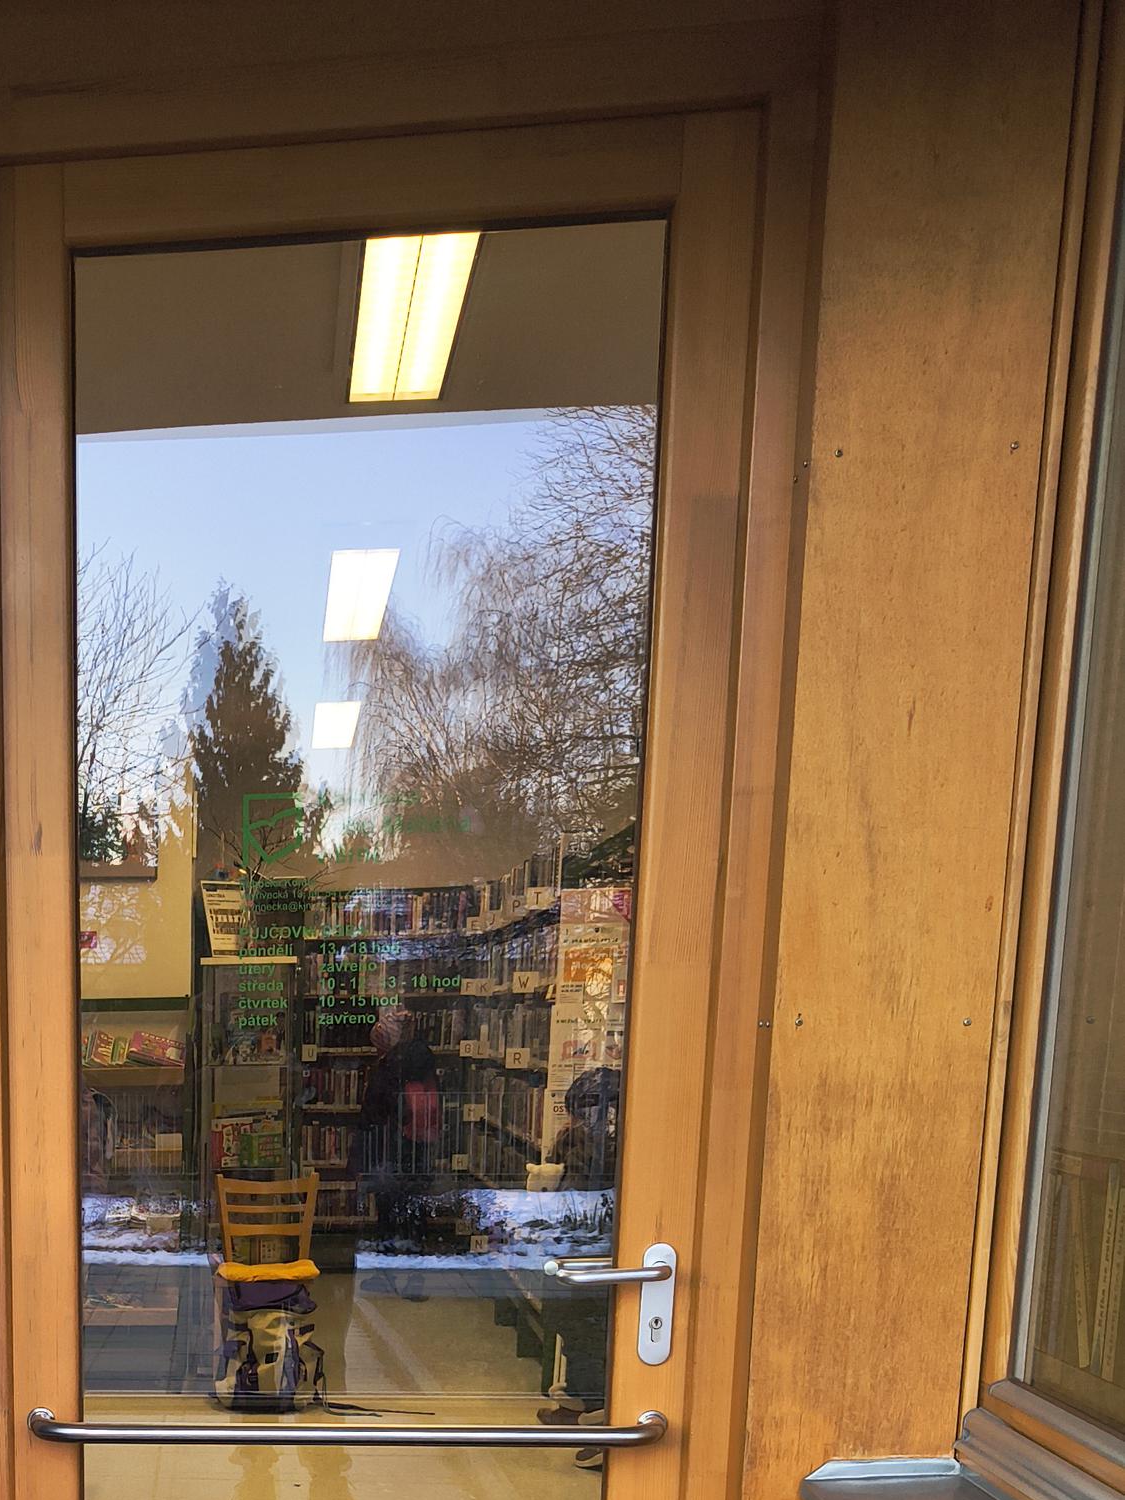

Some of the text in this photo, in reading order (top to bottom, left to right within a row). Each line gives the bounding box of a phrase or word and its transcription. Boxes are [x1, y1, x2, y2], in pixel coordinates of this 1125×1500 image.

[239, 943, 294, 960] pondělí
[319, 943, 335, 955] 13
[350, 941, 366, 955] 18
[239, 978, 284, 992] středa
[411, 976, 427, 988] 18
[517, 975, 530, 988] W
[239, 996, 288, 1009] čtvrtek
[318, 996, 335, 1008] 10
[350, 995, 366, 1007] 15
[371, 994, 402, 1007] hod.
[239, 1011, 377, 1029] pátek zavřeno
